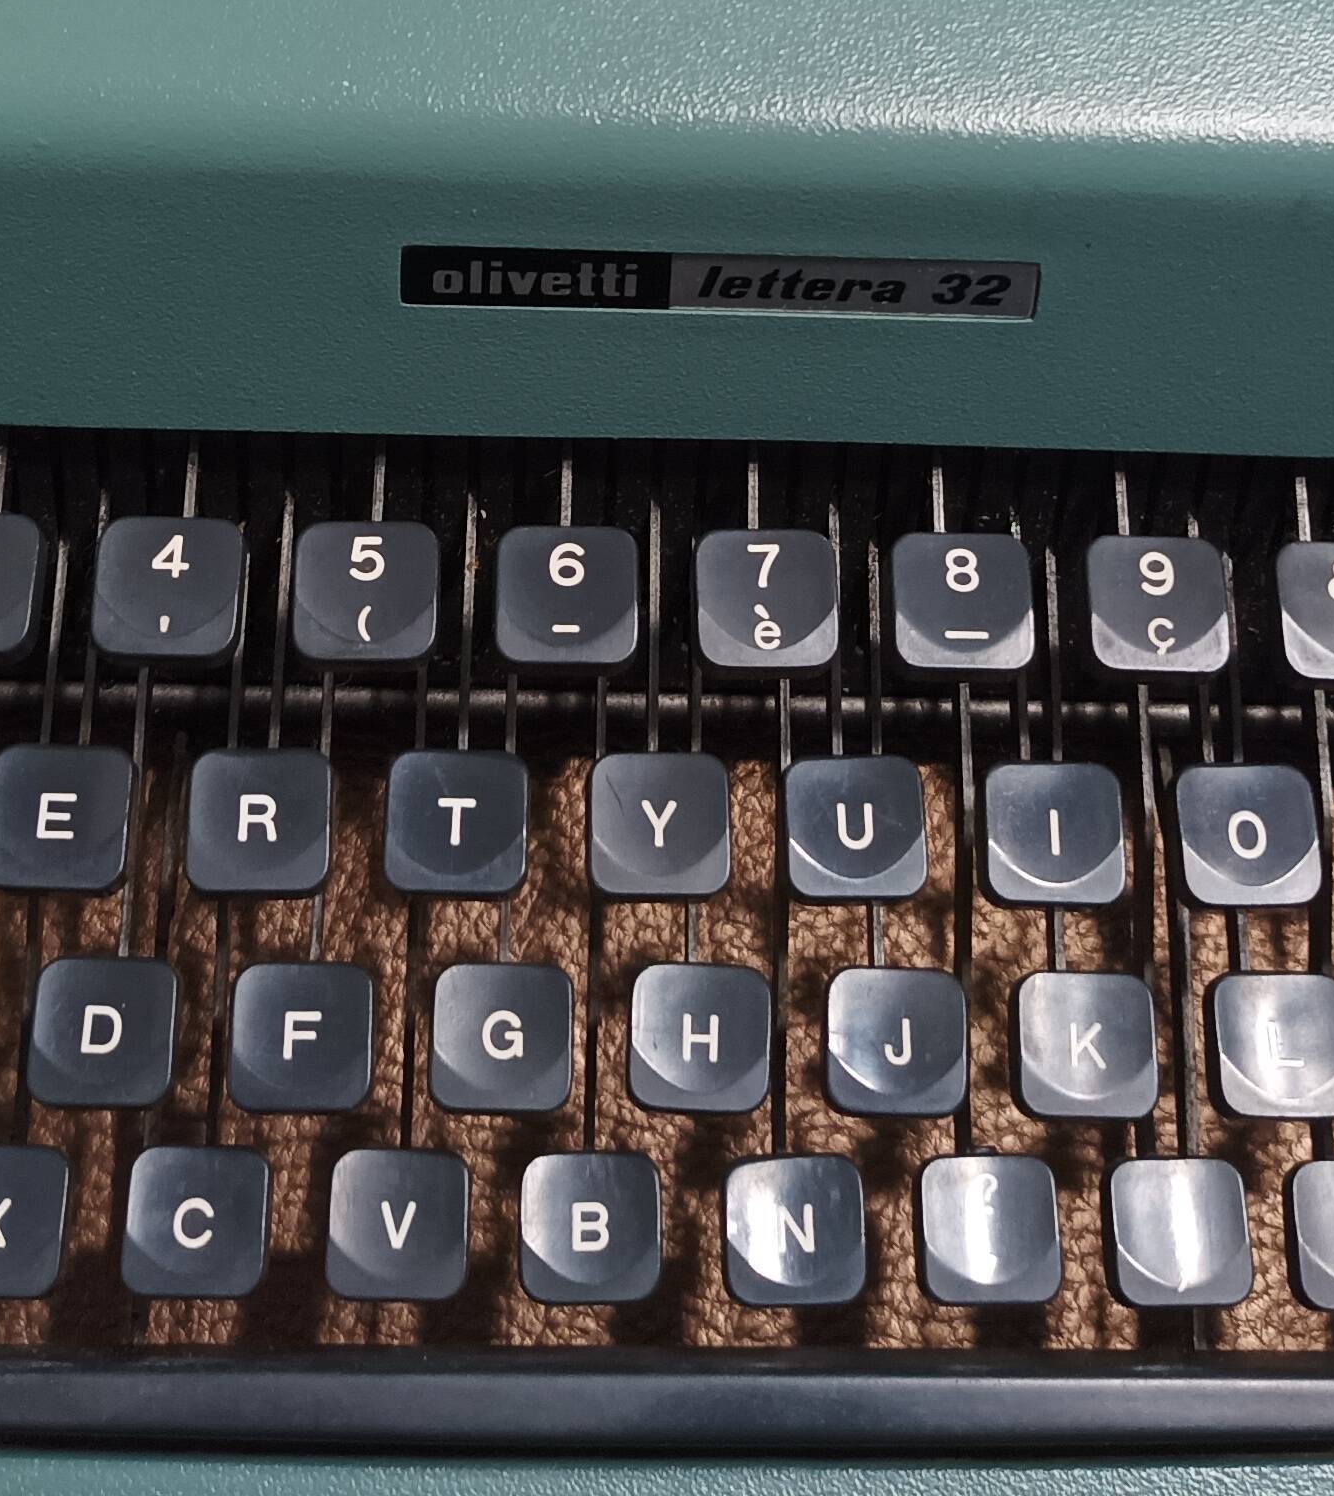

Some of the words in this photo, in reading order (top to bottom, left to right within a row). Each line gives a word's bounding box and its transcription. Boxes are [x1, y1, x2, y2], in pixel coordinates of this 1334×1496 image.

[431, 260, 638, 298] olivetti
[697, 265, 906, 305] lettera
[932, 273, 1012, 307] 32
[151, 535, 189, 578] 4
[349, 536, 385, 581] 5
[548, 542, 585, 586] 6
[747, 543, 780, 588] 7
[944, 548, 979, 592] 8
[1138, 552, 1174, 595] 9
[753, 604, 781, 649] è
[1147, 618, 1175, 656] ç
[36, 792, 77, 840] E
[238, 793, 277, 842] R
[438, 797, 476, 846] T
[641, 800, 676, 847] Y
[837, 802, 873, 850] U
[1050, 809, 1060, 856] I
[1228, 810, 1266, 860] O
[80, 1004, 123, 1054] D
[283, 1011, 322, 1061] F
[482, 1010, 524, 1060] G
[682, 1013, 718, 1063] H
[884, 1017, 911, 1066] J
[1069, 1021, 1107, 1070] K
[1267, 1020, 1304, 1069] L
[172, 1197, 215, 1250] C
[381, 1201, 417, 1250] V
[572, 1202, 609, 1253] B
[776, 1203, 815, 1254] N
